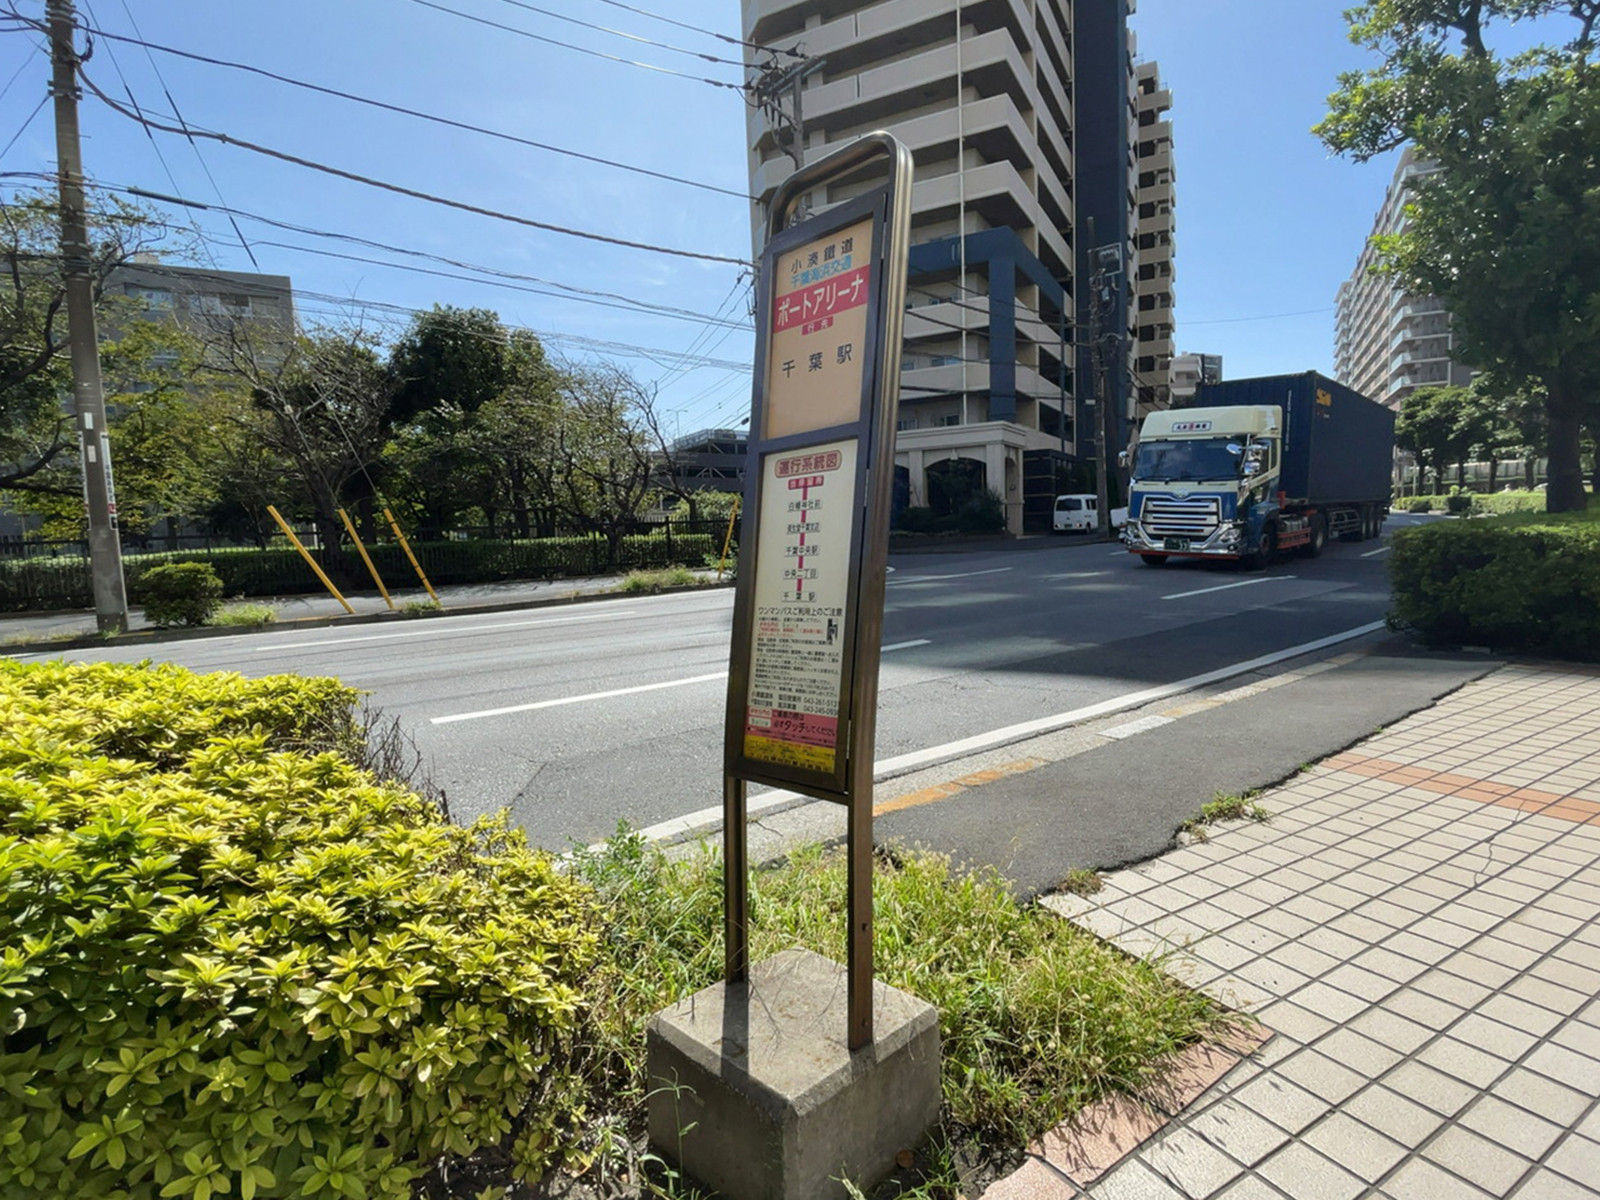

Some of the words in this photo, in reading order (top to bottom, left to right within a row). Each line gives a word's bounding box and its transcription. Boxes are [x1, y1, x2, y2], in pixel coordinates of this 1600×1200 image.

[777, 273, 864, 327] ポートアリーナ
[782, 343, 852, 378] 千葉駅
[779, 453, 838, 475] 運行系統図
